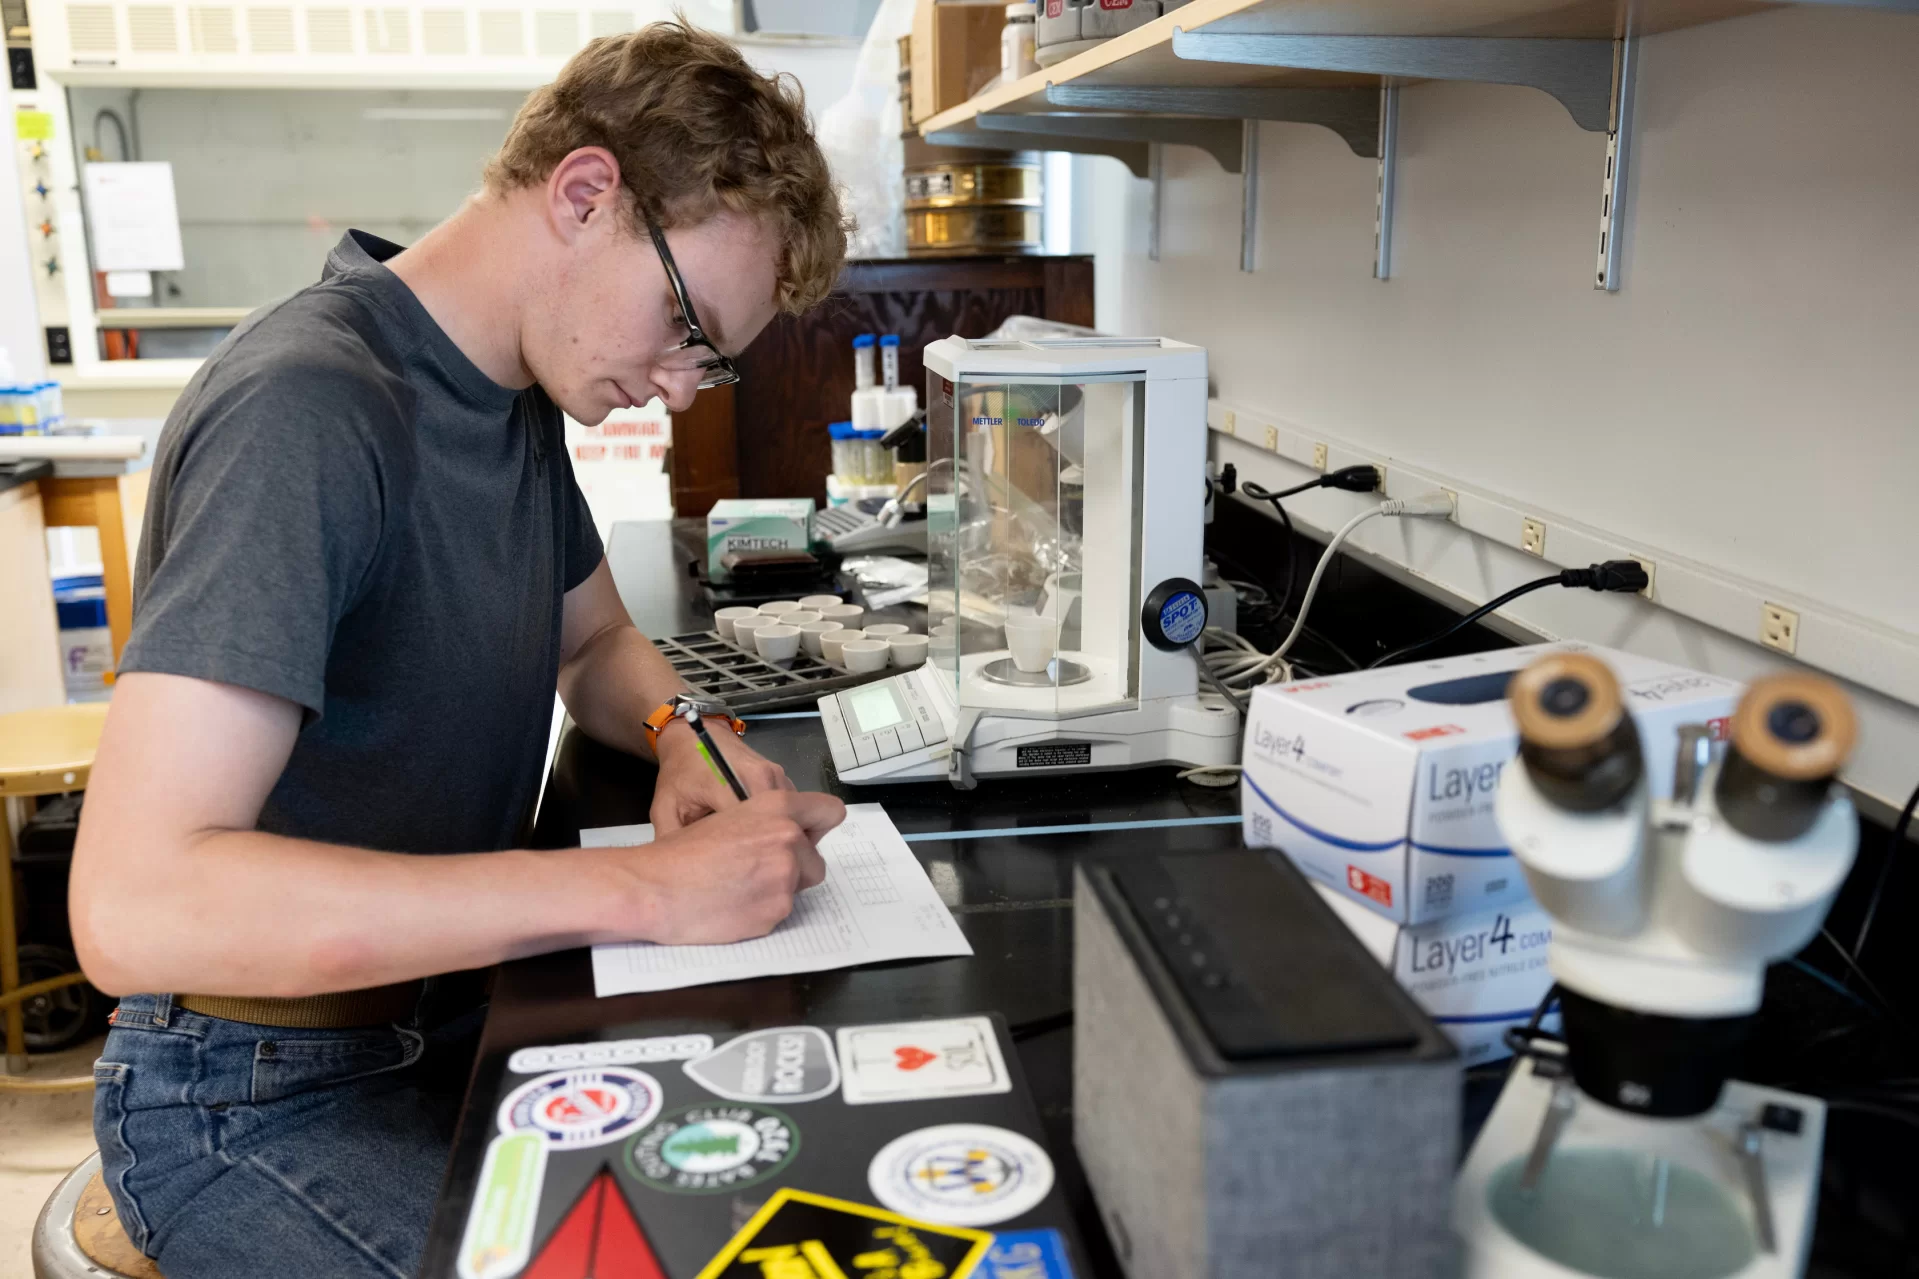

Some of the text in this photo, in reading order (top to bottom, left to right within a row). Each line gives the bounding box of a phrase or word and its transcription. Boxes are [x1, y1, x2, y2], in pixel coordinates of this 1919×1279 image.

[1017, 418, 1045, 427] TOLEDO
[727, 538, 789, 551] KIMTECH
[1163, 600, 1198, 629] SPOT
[1411, 914, 1515, 974] Layer4
